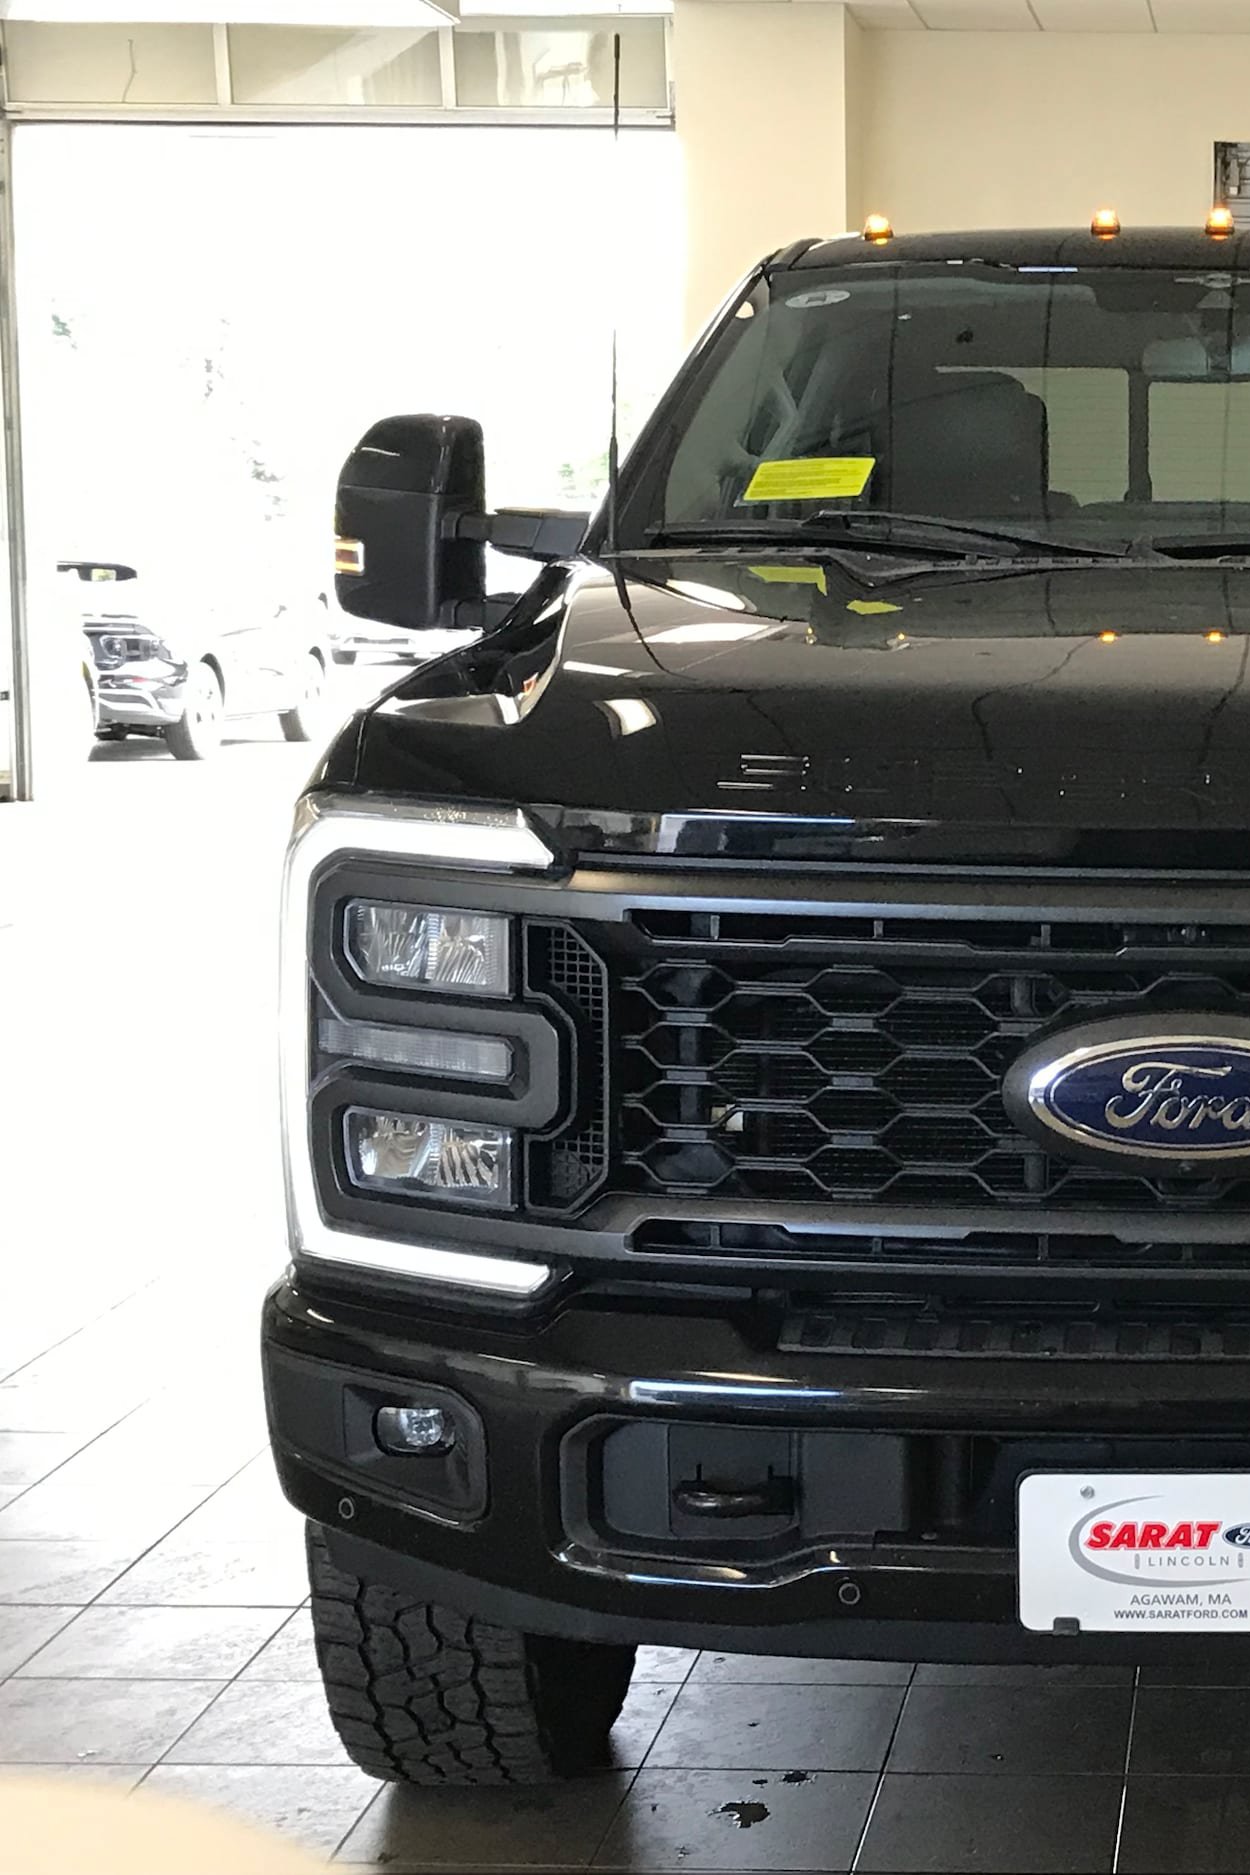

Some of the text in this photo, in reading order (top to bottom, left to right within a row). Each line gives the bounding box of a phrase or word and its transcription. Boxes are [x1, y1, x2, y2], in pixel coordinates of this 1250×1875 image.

[1085, 1520, 1222, 1550] SARAT
[1147, 1555, 1231, 1567] LINCOLN
[1130, 1593, 1232, 1607] AGAWAM, MA
[1113, 1608, 1249, 1620] WWW.SARATFORD.COM
